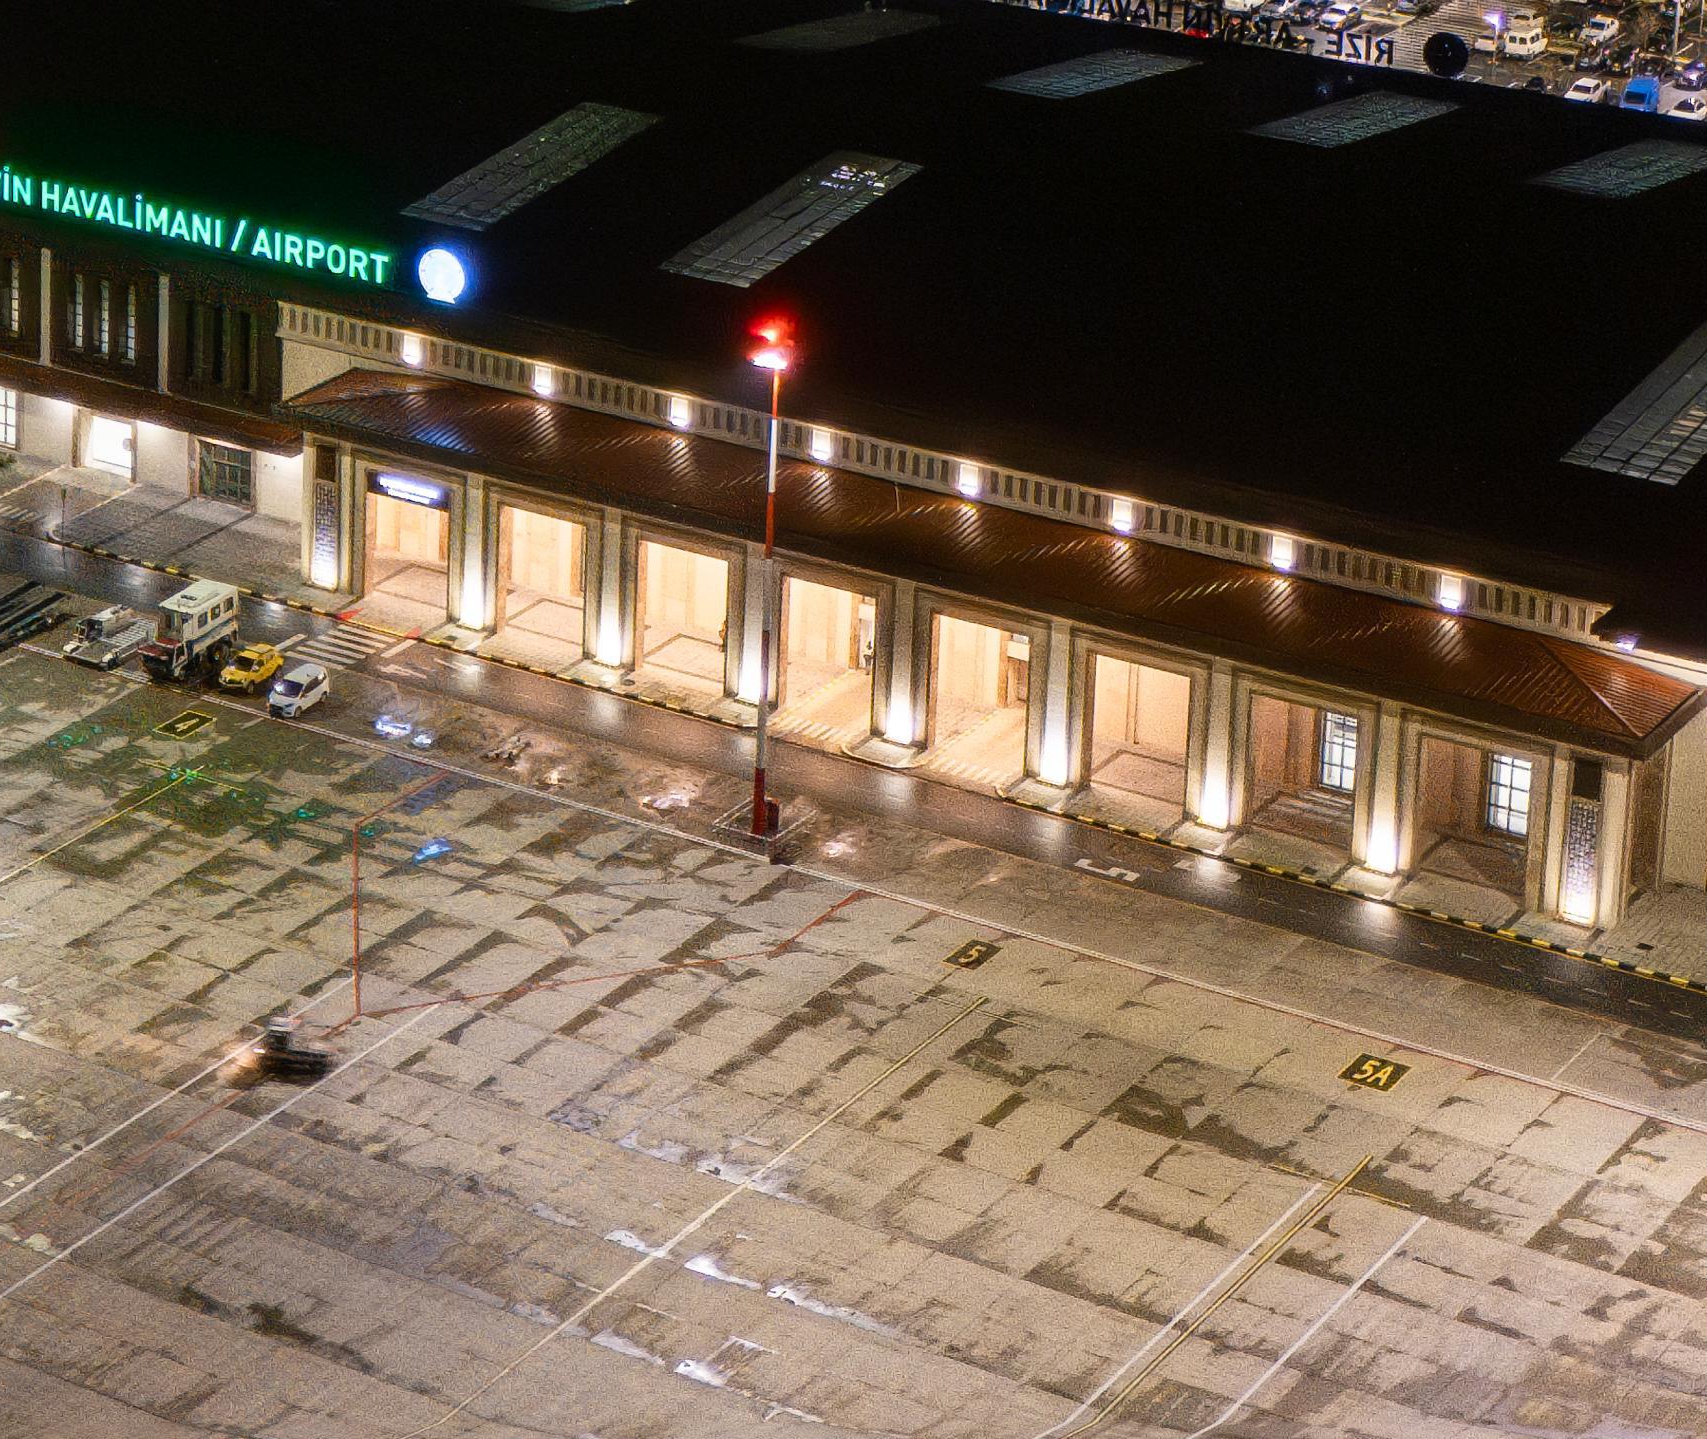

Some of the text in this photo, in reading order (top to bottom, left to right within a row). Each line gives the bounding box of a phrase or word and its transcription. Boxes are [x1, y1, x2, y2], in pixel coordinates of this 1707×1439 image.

[41, 180, 222, 248] HAVALİMANI
[230, 219, 247, 253] /
[251, 227, 390, 285] AIRPORT
[958, 944, 987, 964] 5
[1352, 1059, 1395, 1087] 5A
